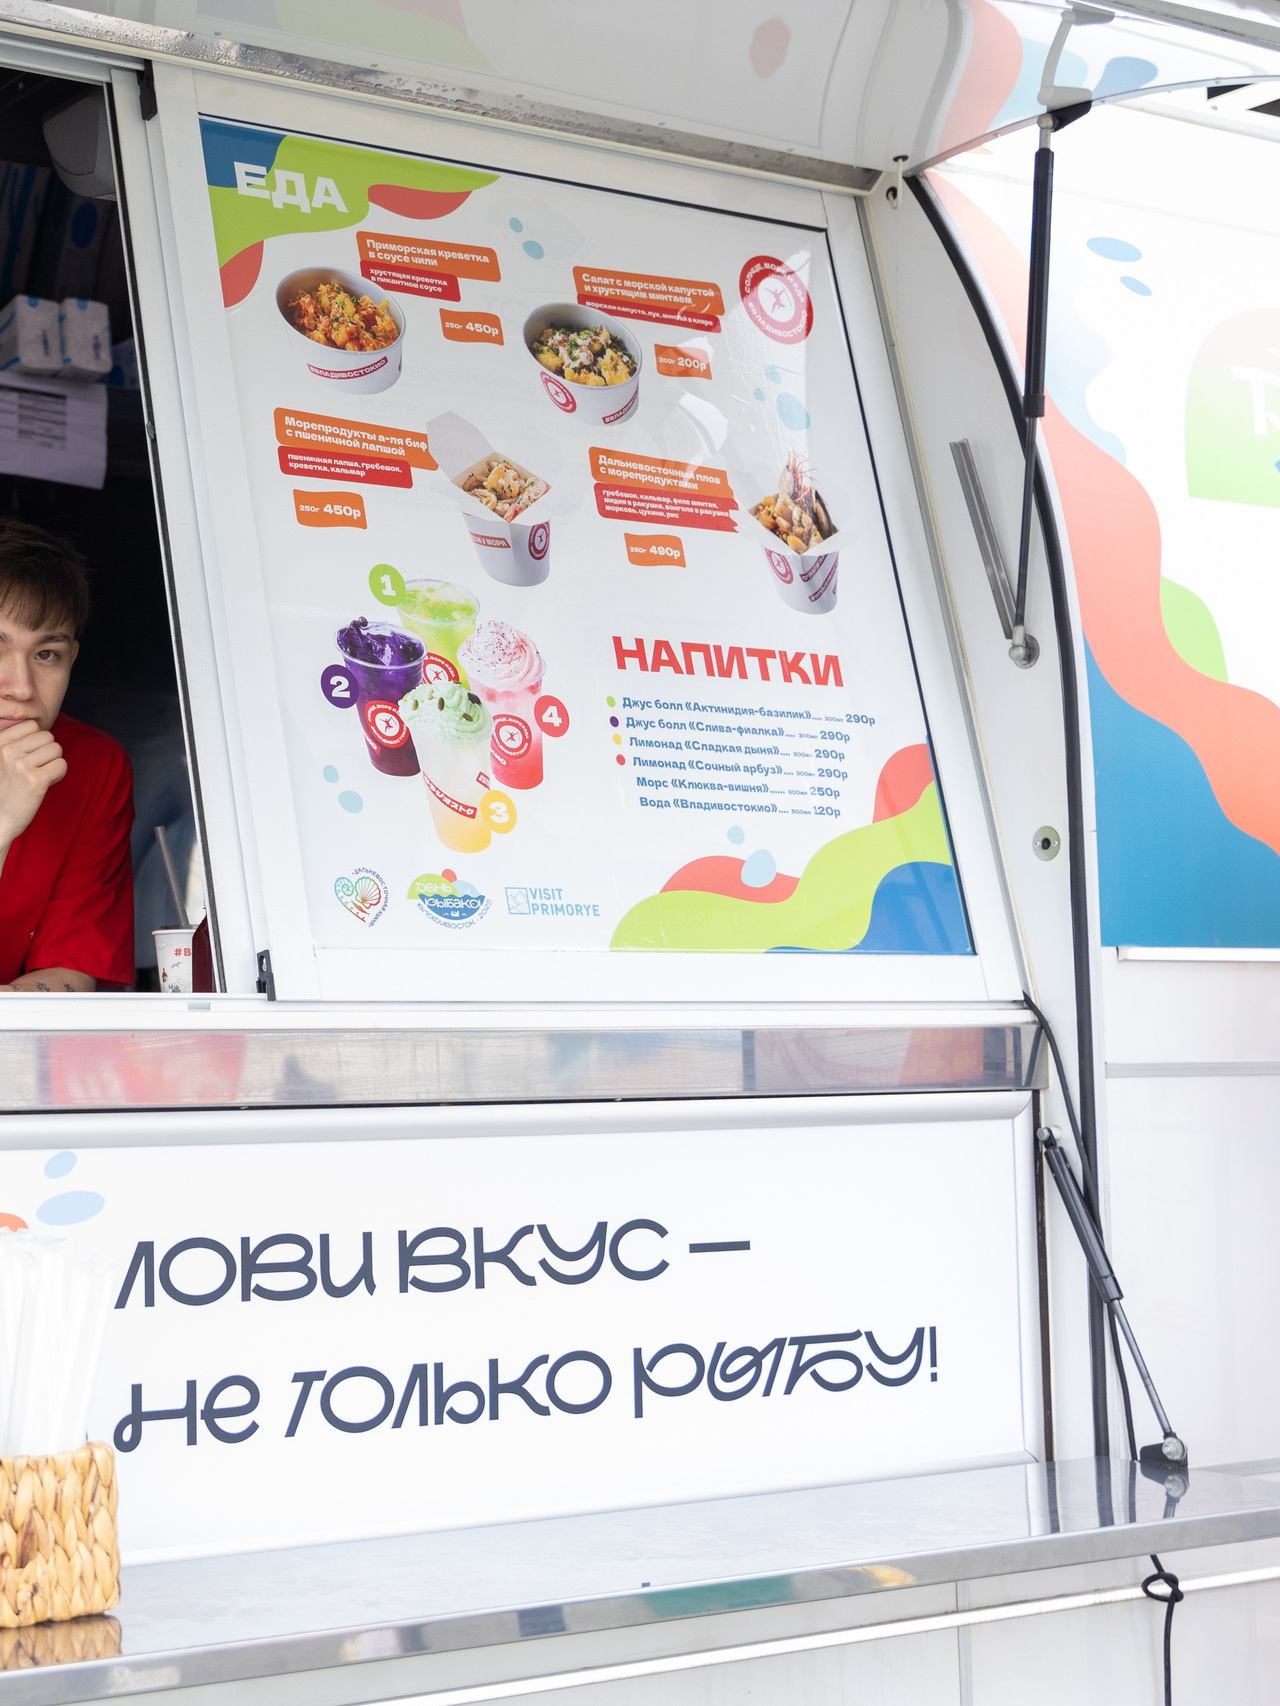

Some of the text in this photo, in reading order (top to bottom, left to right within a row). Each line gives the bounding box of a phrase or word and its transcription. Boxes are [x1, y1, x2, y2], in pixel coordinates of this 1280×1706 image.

[234, 161, 348, 214] ЕДА
[366, 239, 490, 263] Приморская креветка
[368, 251, 438, 266] в соусе чили
[370, 268, 448, 286] хрустящая креветка
[377, 277, 419, 289] пикантном
[419, 283, 443, 293] соусе
[582, 273, 615, 286] Салат
[623, 280, 668, 292] морской
[668, 285, 715, 298] капустой
[592, 286, 648, 299] хрустящим
[648, 293, 693, 304] минтаем
[585, 301, 617, 310] морская
[617, 305, 647, 317] капуста,
[445, 321, 499, 337] 250г 450р
[310, 359, 386, 379] #ВЛАДИВОСТОКИО
[659, 356, 707, 371] 200г 200р
[285, 416, 428, 451] Морепродукты а-ля биф
[285, 429, 406, 456] с пшеничной лапшой
[288, 453, 402, 473] пшеничная лапша, гребешок,
[289, 462, 366, 477] креветка, кальмар
[598, 454, 721, 485] Дальневосточный плов
[608, 468, 699, 490] морепродуктами
[603, 490, 639, 500] гребешок,
[640, 494, 672, 504] кальмар,
[299, 503, 361, 519] 250г 450р
[649, 545, 680, 560] 490р
[381, 574, 396, 596] 1
[612, 635, 844, 687] НАПИТКИ
[329, 675, 351, 698] 2
[541, 705, 562, 727] 4
[622, 697, 652, 711] Джус
[655, 699, 683, 711] болл
[845, 713, 875, 727] 290р
[625, 716, 656, 730] Джус
[658, 719, 687, 730] болл
[819, 730, 850, 744] 290р
[629, 737, 683, 751] Лимонад
[684, 740, 743, 754] «Сладкая
[814, 749, 845, 762] 290р
[633, 757, 686, 771] Лимонад
[688, 760, 741, 772] «Сочный
[817, 768, 848, 781] 290р
[636, 777, 669, 790] Морс
[809, 786, 840, 800] 250р
[488, 801, 510, 824] 3
[640, 797, 671, 809] Вода
[813, 805, 841, 819] 120р
[354, 867, 389, 912] ДАЛЬНЕВОСТОЧНАЯ
[529, 887, 563, 900] VISIT
[532, 903, 600, 917] PRIMORYE
[113, 1232, 377, 1310] ЛОВИ
[399, 1218, 670, 1294] ВКУС
[284, 1349, 613, 1439] ТОЛЬКО
